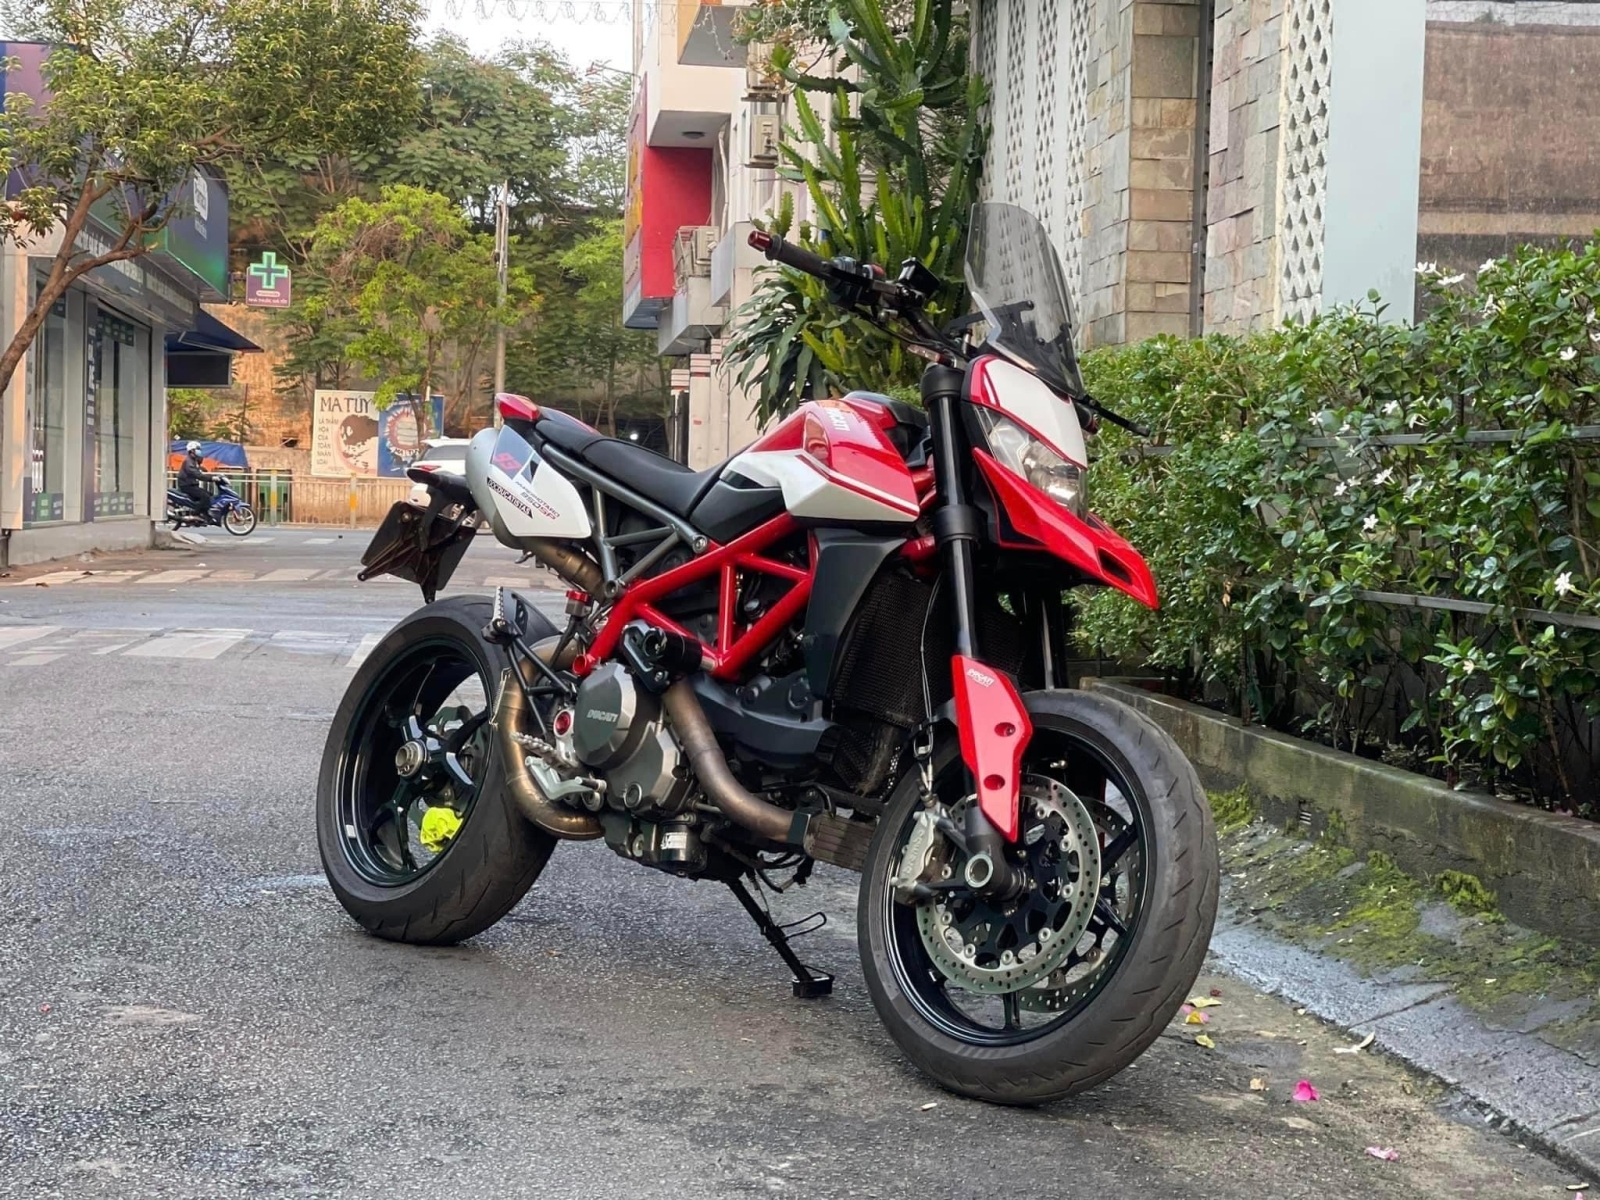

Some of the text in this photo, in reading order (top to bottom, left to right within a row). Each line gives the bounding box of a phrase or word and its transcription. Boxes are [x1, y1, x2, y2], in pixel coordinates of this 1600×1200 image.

[320, 396, 342, 412] MA
[343, 394, 372, 413] TÚY
[586, 708, 619, 723] DUCATI
